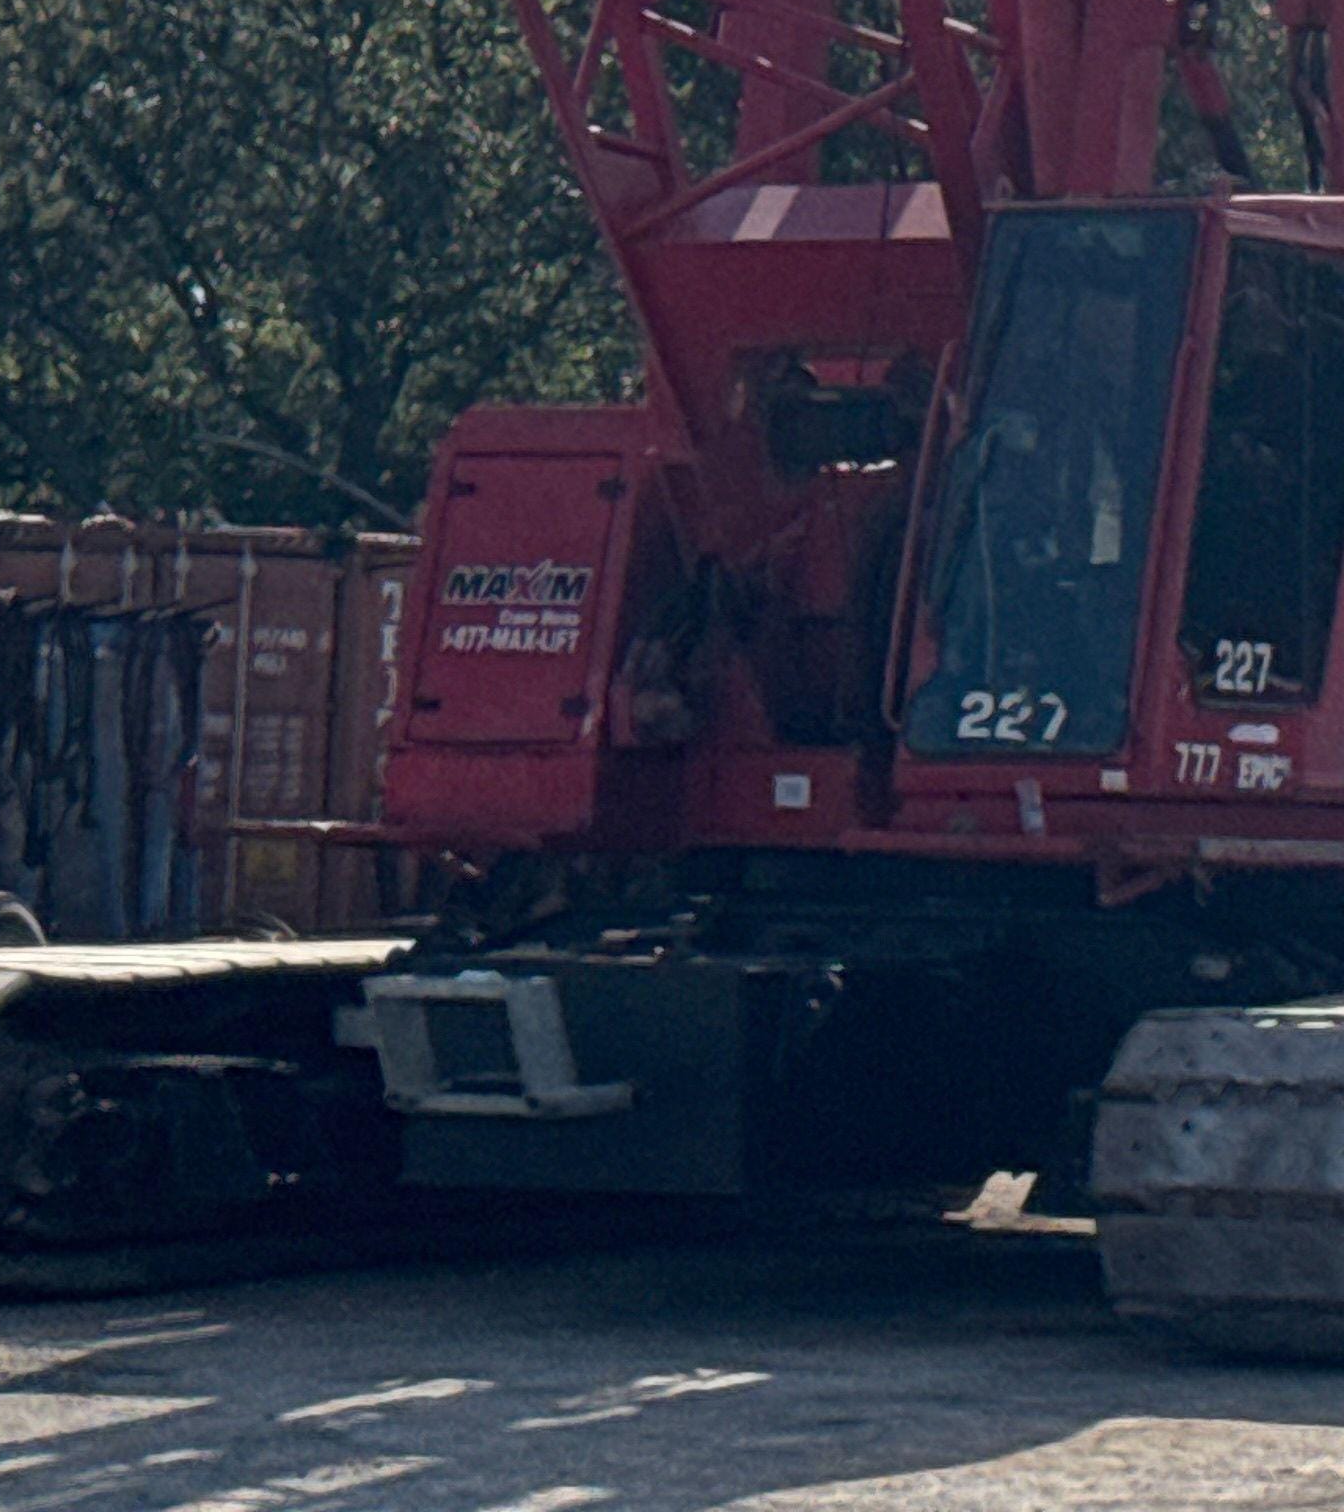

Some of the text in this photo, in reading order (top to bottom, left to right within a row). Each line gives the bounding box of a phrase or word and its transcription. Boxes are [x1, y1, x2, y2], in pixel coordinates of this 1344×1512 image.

[441, 558, 593, 605] MAXIM
[1215, 639, 1272, 694] 227
[956, 686, 1068, 743] 227
[1175, 742, 1222, 784] 777
